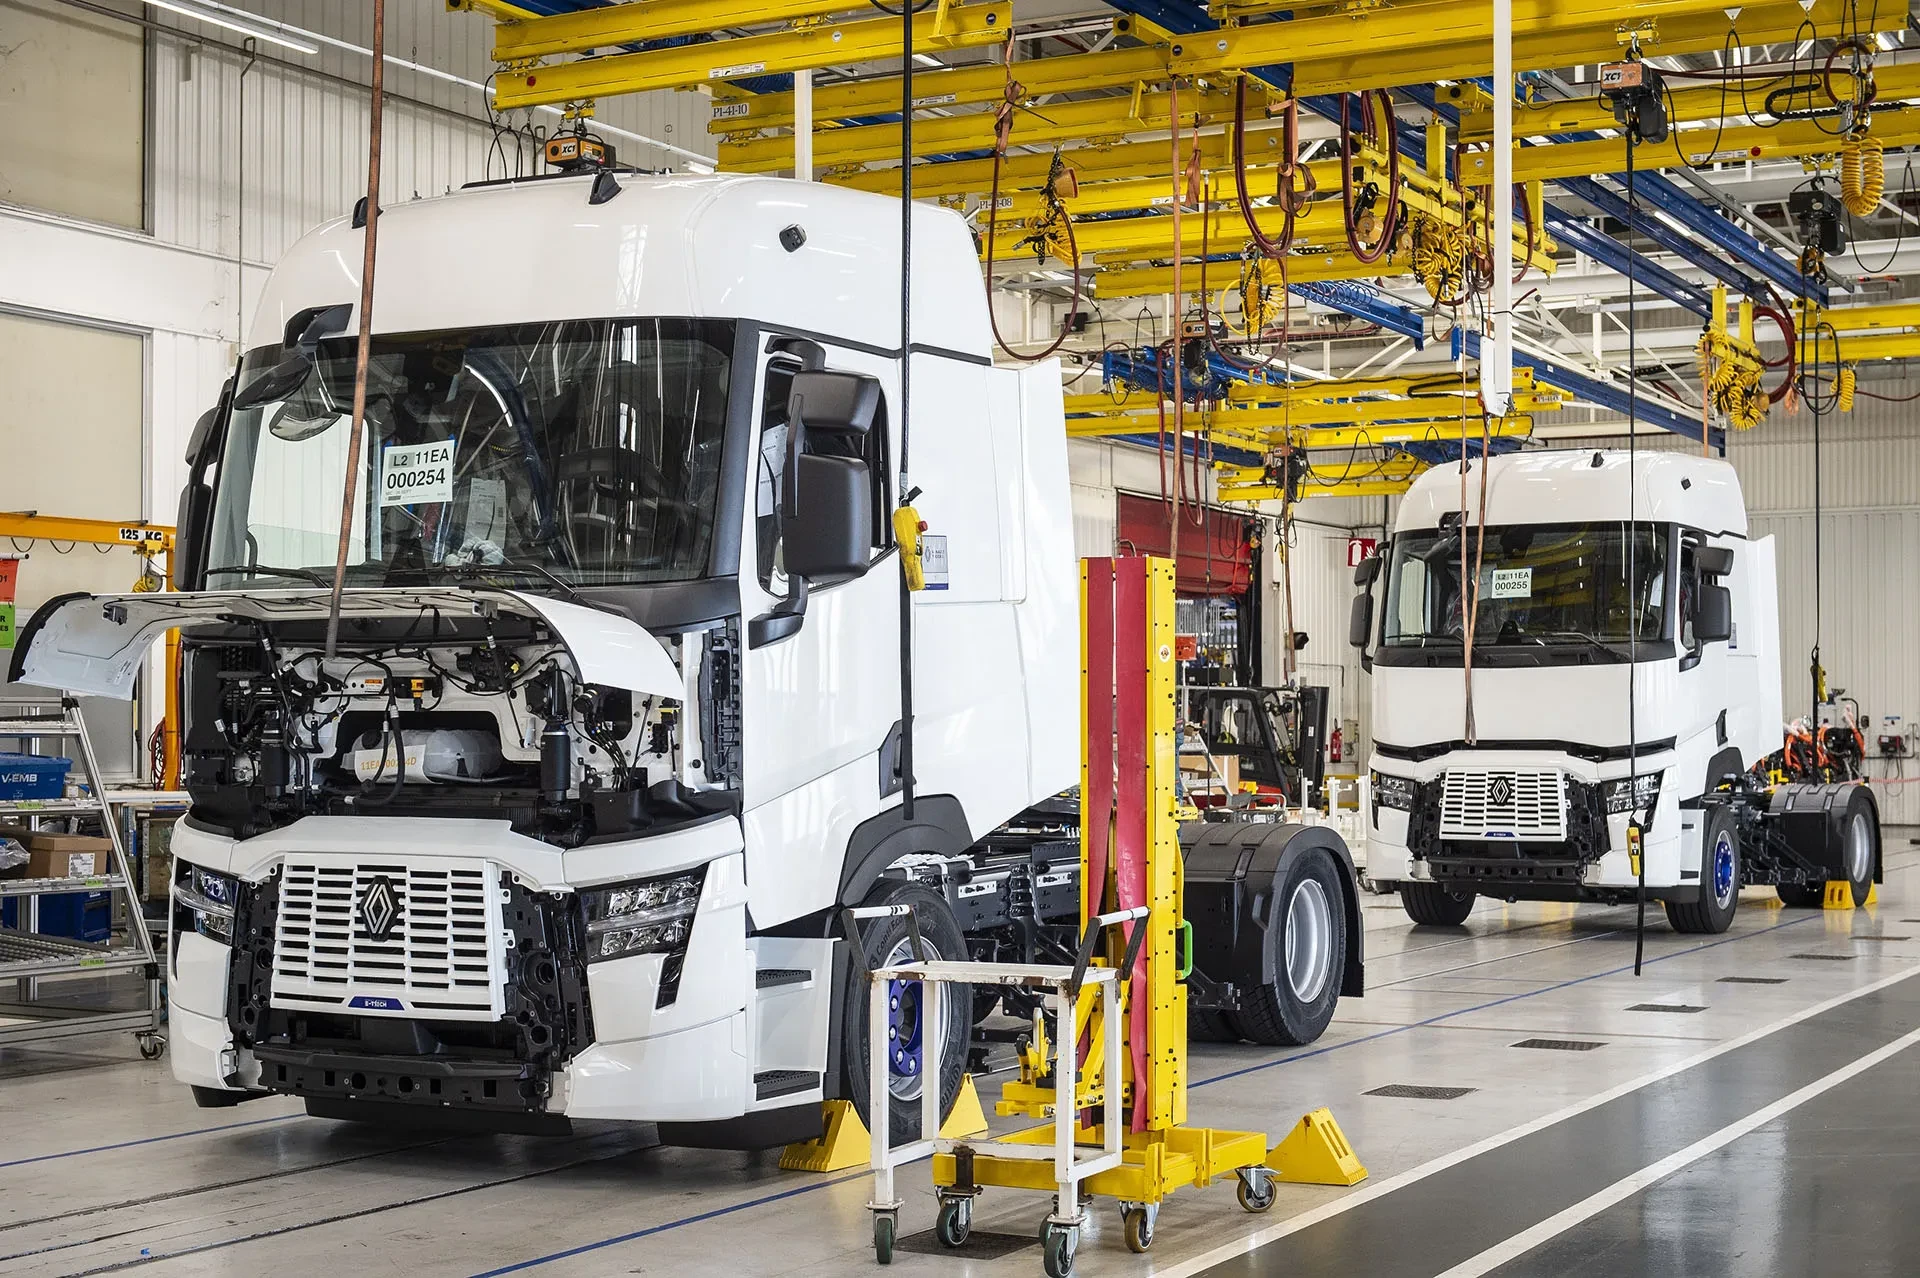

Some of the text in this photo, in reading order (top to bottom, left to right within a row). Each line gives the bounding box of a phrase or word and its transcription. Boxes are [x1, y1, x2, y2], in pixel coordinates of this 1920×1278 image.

[980, 198, 1013, 209] P1-1-08
[393, 448, 449, 467] L2 11EA
[387, 468, 446, 489] 000254
[121, 529, 162, 541] 125 KG
[1495, 581, 1528, 591] 000255
[361, 757, 417, 770] 11EA004D
